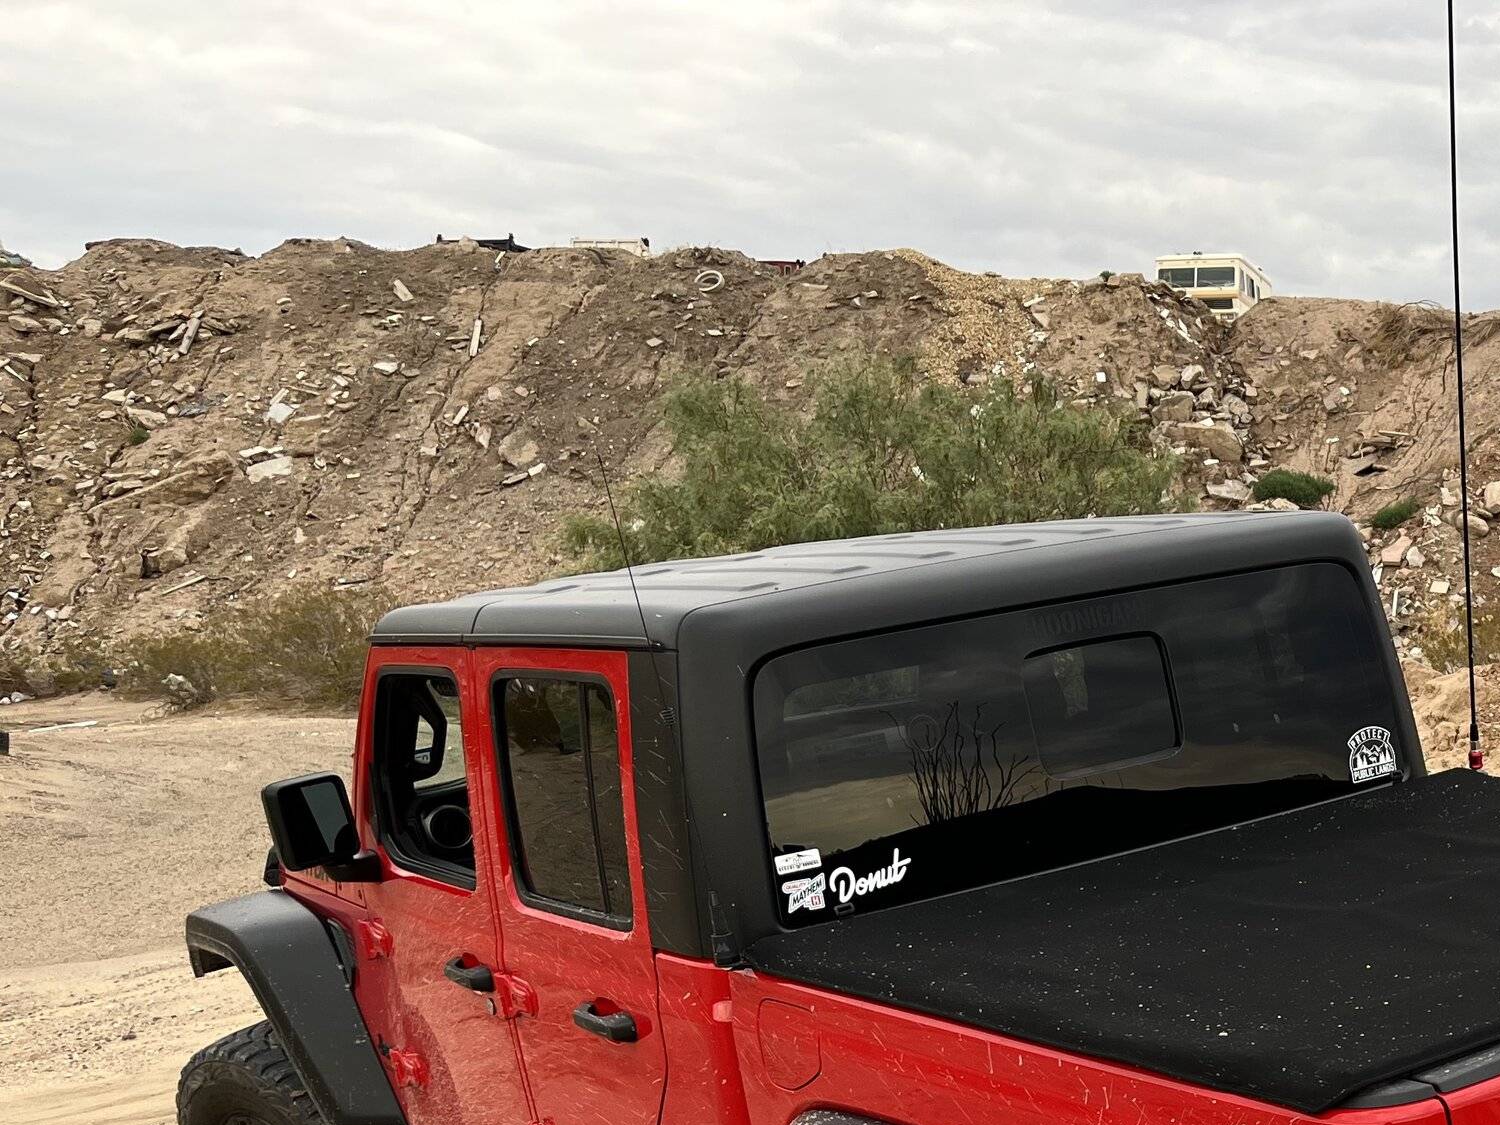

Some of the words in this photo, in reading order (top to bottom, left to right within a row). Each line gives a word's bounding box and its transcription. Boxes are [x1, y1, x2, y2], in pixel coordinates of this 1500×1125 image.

[1350, 728, 1389, 749] PROTECT
[1353, 768, 1375, 780] PUBLIC
[1375, 763, 1394, 775] LANDS
[829, 848, 912, 903] Donut
[792, 878, 823, 906] MAYHEM
